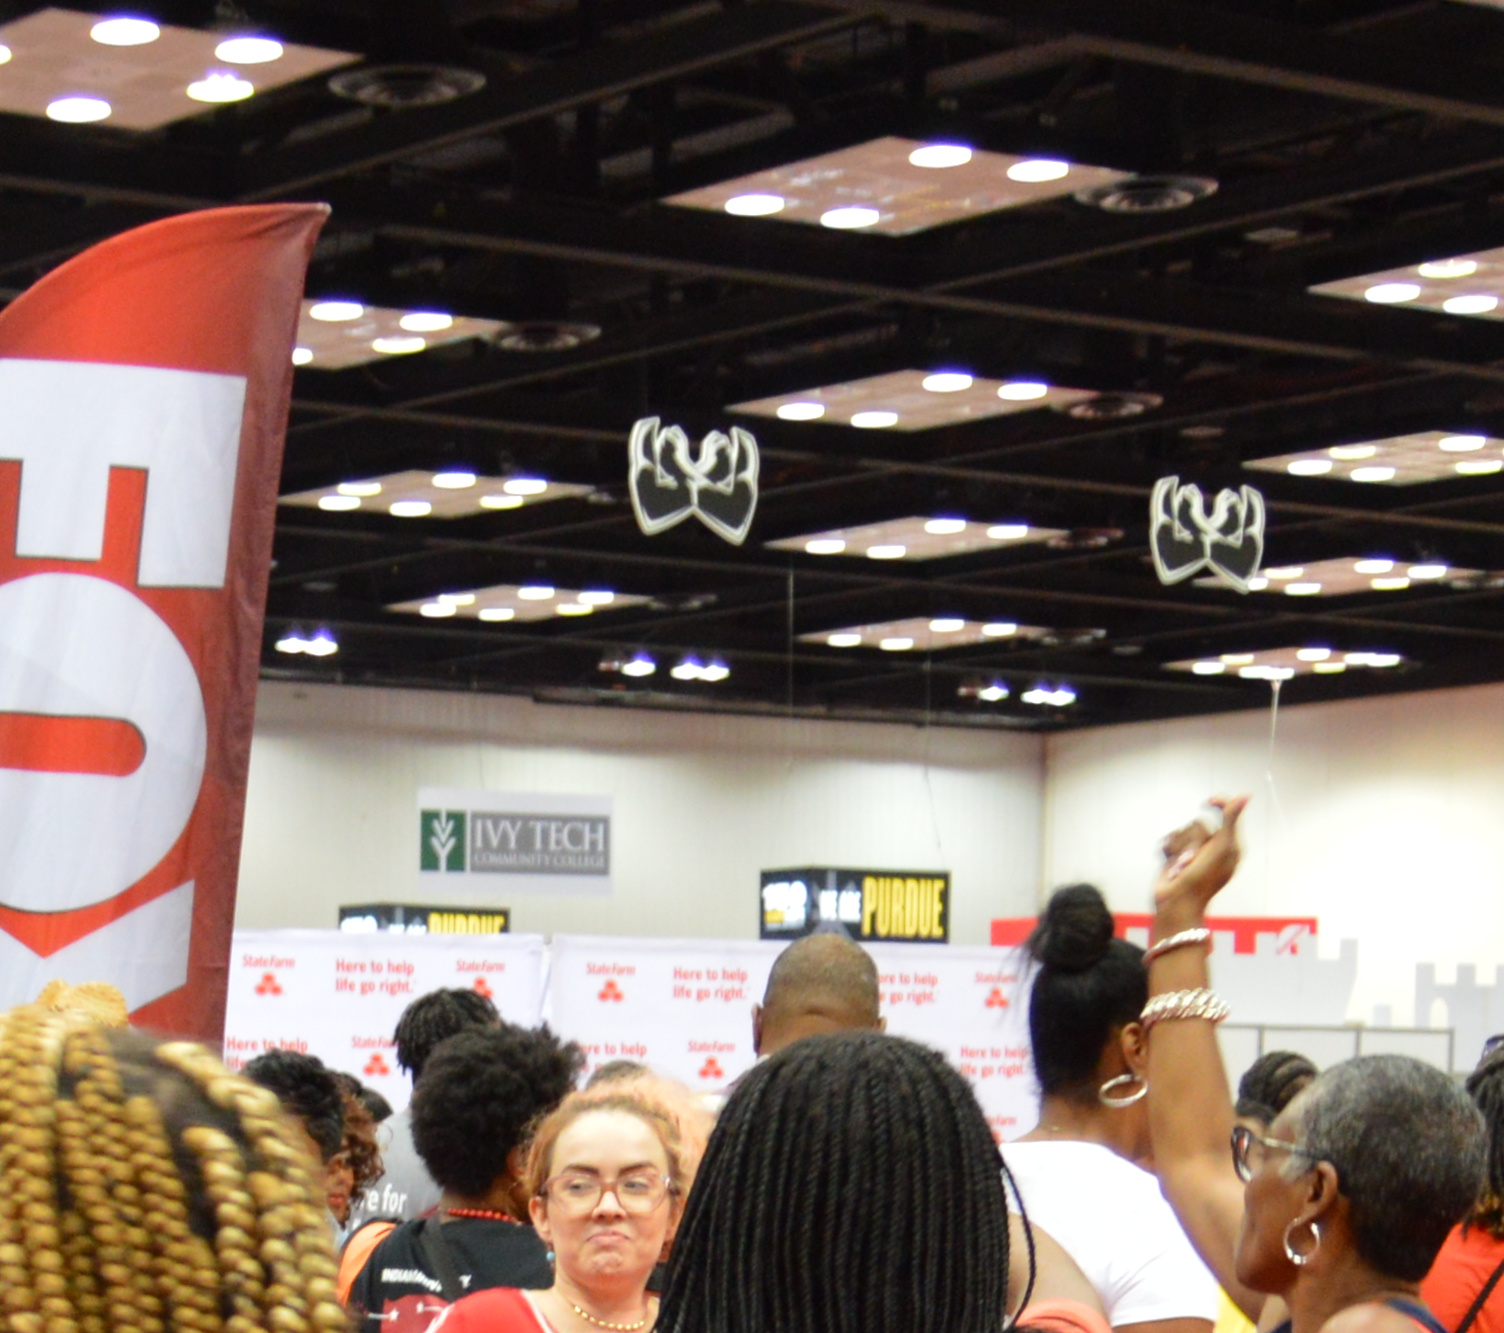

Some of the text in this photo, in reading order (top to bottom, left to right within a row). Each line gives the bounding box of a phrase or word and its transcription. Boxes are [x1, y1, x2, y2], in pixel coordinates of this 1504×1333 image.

[474, 817, 605, 852] IVY TECH
[861, 875, 945, 938] PURDUE
[336, 959, 414, 976] Here to help
[674, 967, 749, 984] Here to help
[336, 979, 355, 993] life
[360, 982, 376, 996] go
[878, 971, 938, 987] ere to help
[673, 986, 692, 1000] life
[696, 989, 712, 1003] go
[890, 991, 904, 1005] go
[226, 1038, 308, 1054] Here to help
[579, 1043, 648, 1061] ere to help
[961, 1045, 1028, 1060] Here to help
[981, 1066, 995, 1079] go
[383, 1183, 408, 1214] for
